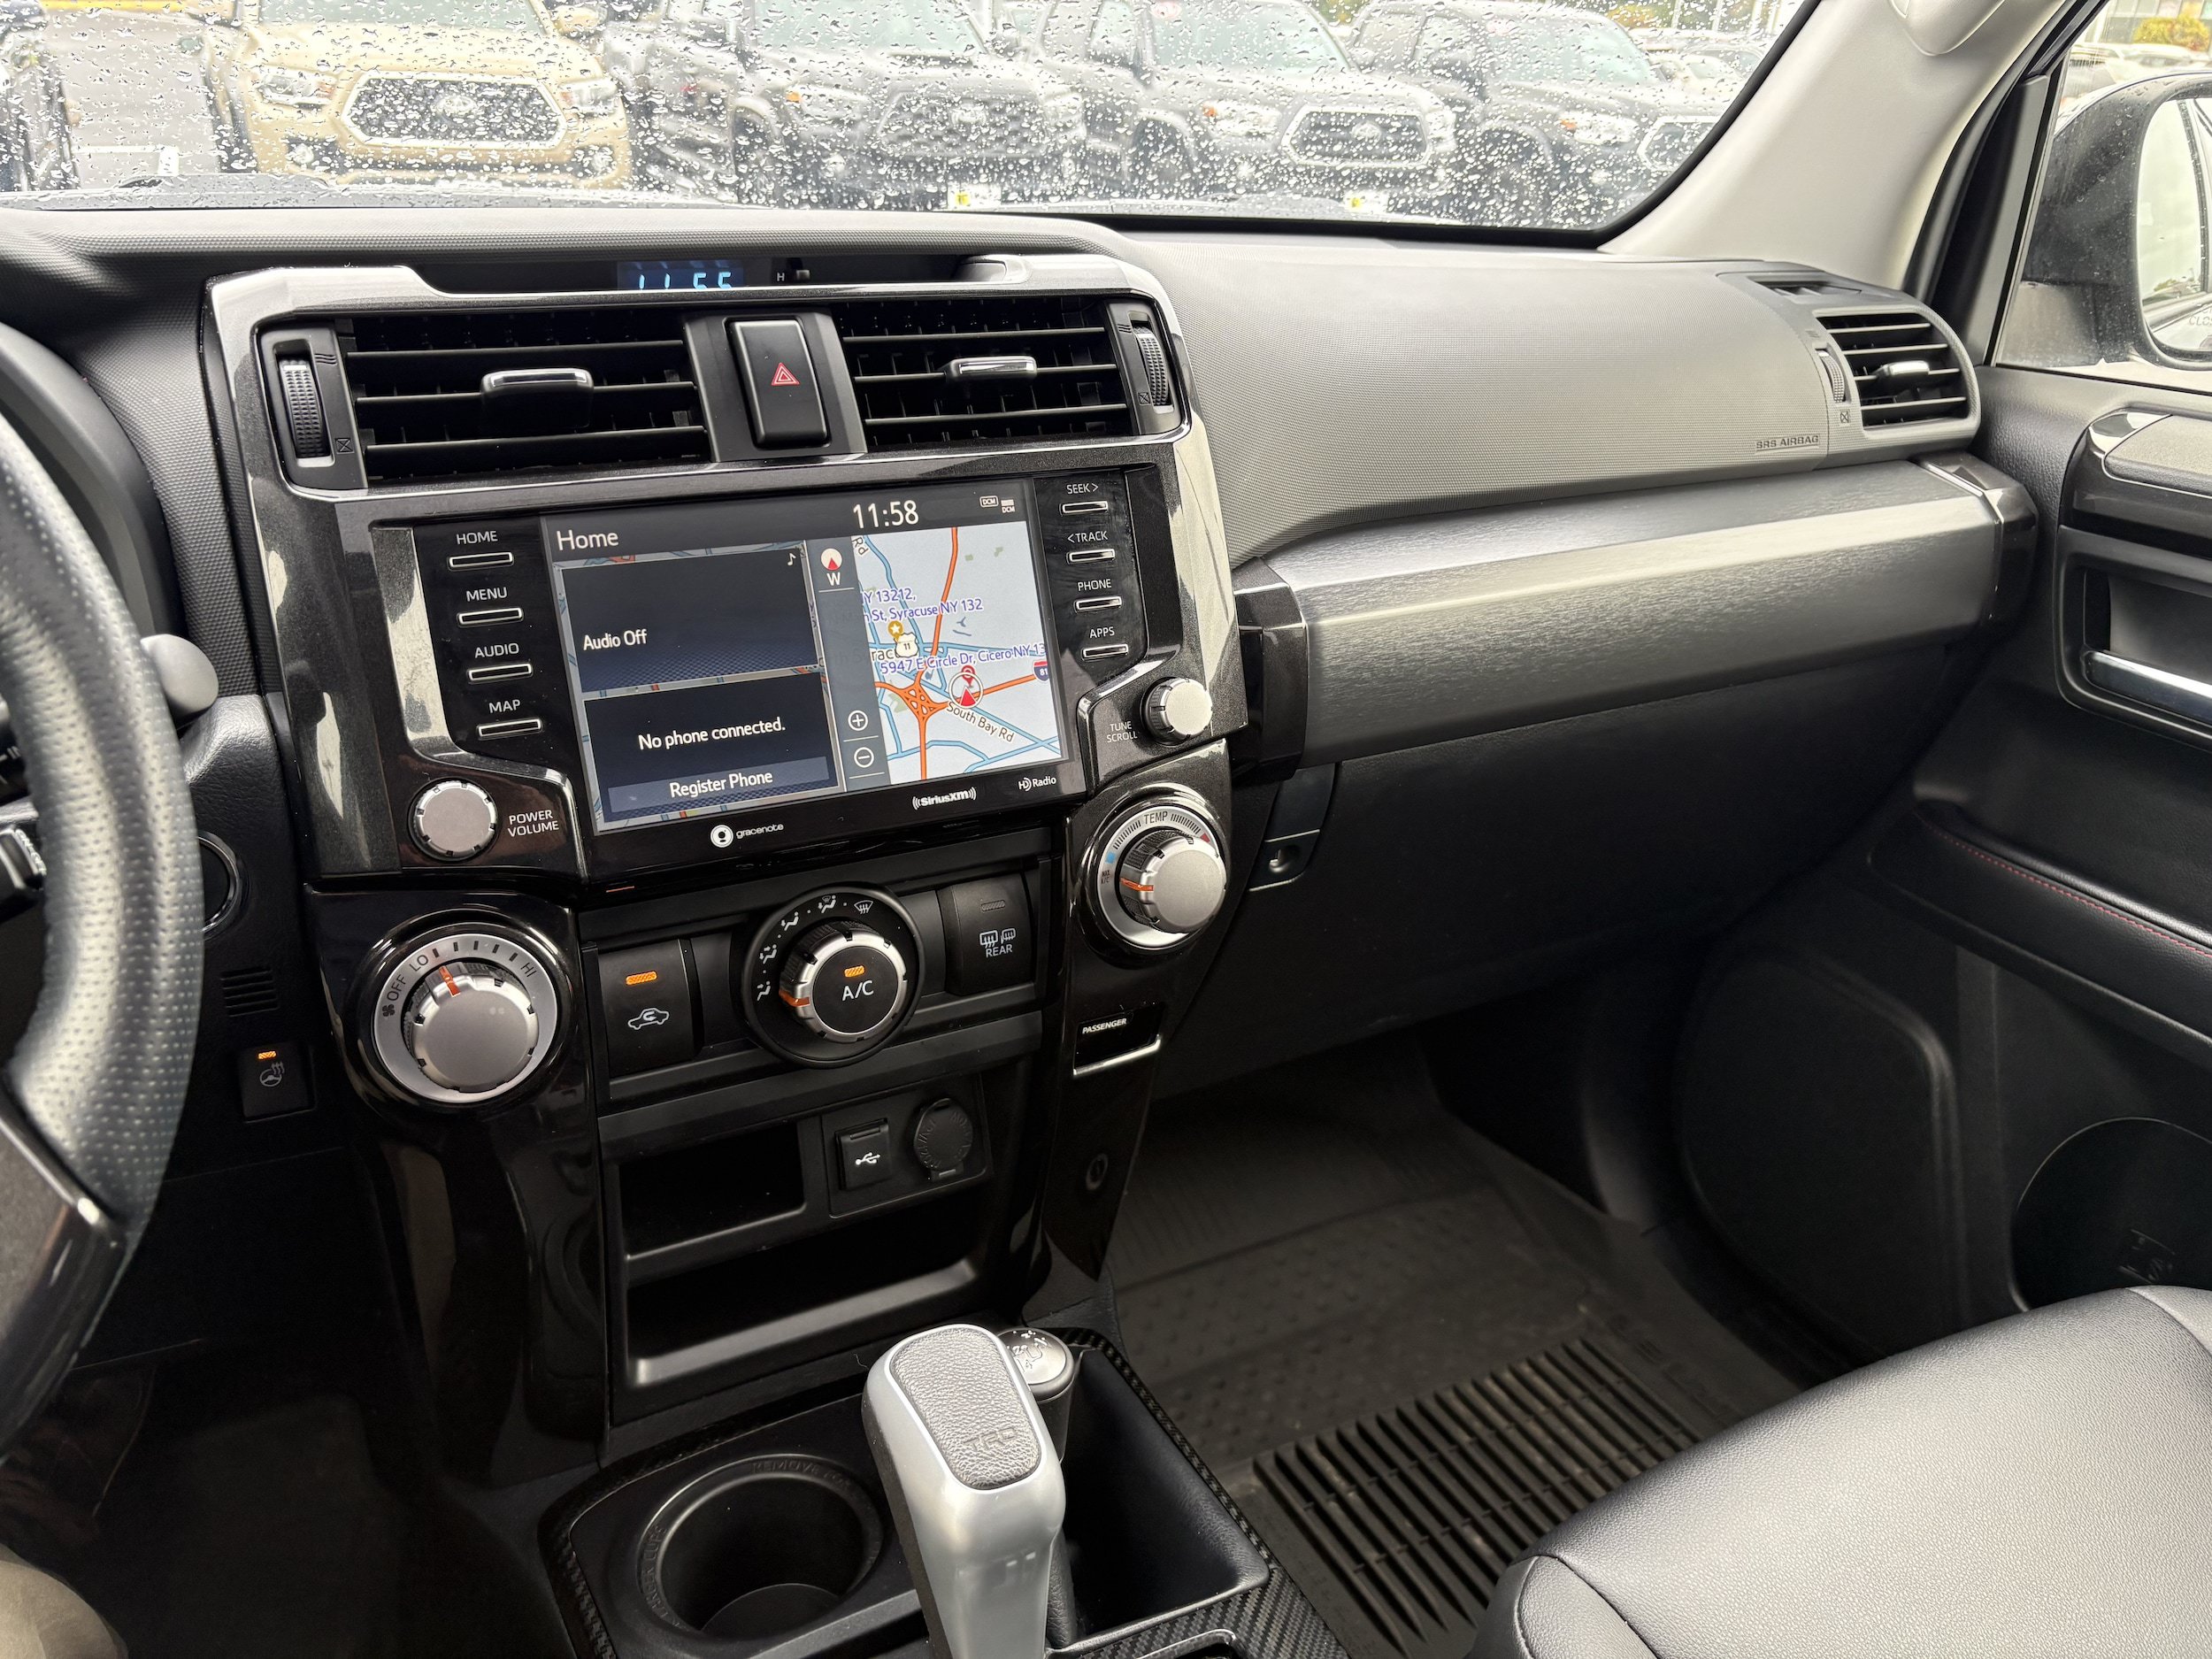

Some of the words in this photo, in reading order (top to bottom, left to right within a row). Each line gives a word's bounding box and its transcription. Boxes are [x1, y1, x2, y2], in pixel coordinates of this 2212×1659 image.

[1755, 440, 1777, 449] SRS
[1778, 435, 1819, 447] AIRBAG
[852, 500, 919, 528] 11:58
[456, 531, 498, 545] HOME
[556, 530, 619, 550] Home
[826, 572, 841, 586] W
[1077, 578, 1112, 591] PHONE
[465, 587, 508, 602] MENU
[876, 588, 916, 603] 13212,
[889, 606, 938, 619] Syracuse
[941, 601, 958, 614] NY
[962, 598, 983, 611] 132
[582, 633, 621, 650] Audio
[623, 629, 648, 646] Off
[1089, 626, 1115, 639] APPS
[474, 642, 519, 658] AUDIO
[880, 660, 913, 674] 5947
[917, 658, 923, 670] E
[926, 654, 957, 669] Circle
[978, 649, 1011, 662] Cicero
[1013, 644, 1031, 657] NY
[488, 699, 521, 713] MAP
[947, 702, 975, 725] South
[978, 718, 998, 736] Bay
[999, 727, 1015, 742] Rd
[1110, 720, 1133, 732] TUNE
[638, 733, 662, 750] No
[665, 730, 709, 749] phone
[711, 716, 786, 741] connected.
[1106, 731, 1138, 742] SCROLL
[670, 777, 726, 798] Register
[729, 772, 773, 789] Phone
[1033, 775, 1056, 787] Radio
[509, 810, 553, 825] POWER
[1143, 810, 1168, 825] TEMP
[508, 820, 559, 837] VOLUME
[735, 822, 784, 839] gracenote
[985, 943, 1013, 958] REAR
[409, 955, 429, 972] LO
[520, 962, 537, 978] HI
[387, 974, 406, 1002] OFF
[841, 979, 874, 1002] A/C
[1082, 1018, 1127, 1034] PASSENGER
[963, 1426, 1017, 1451] TRD
